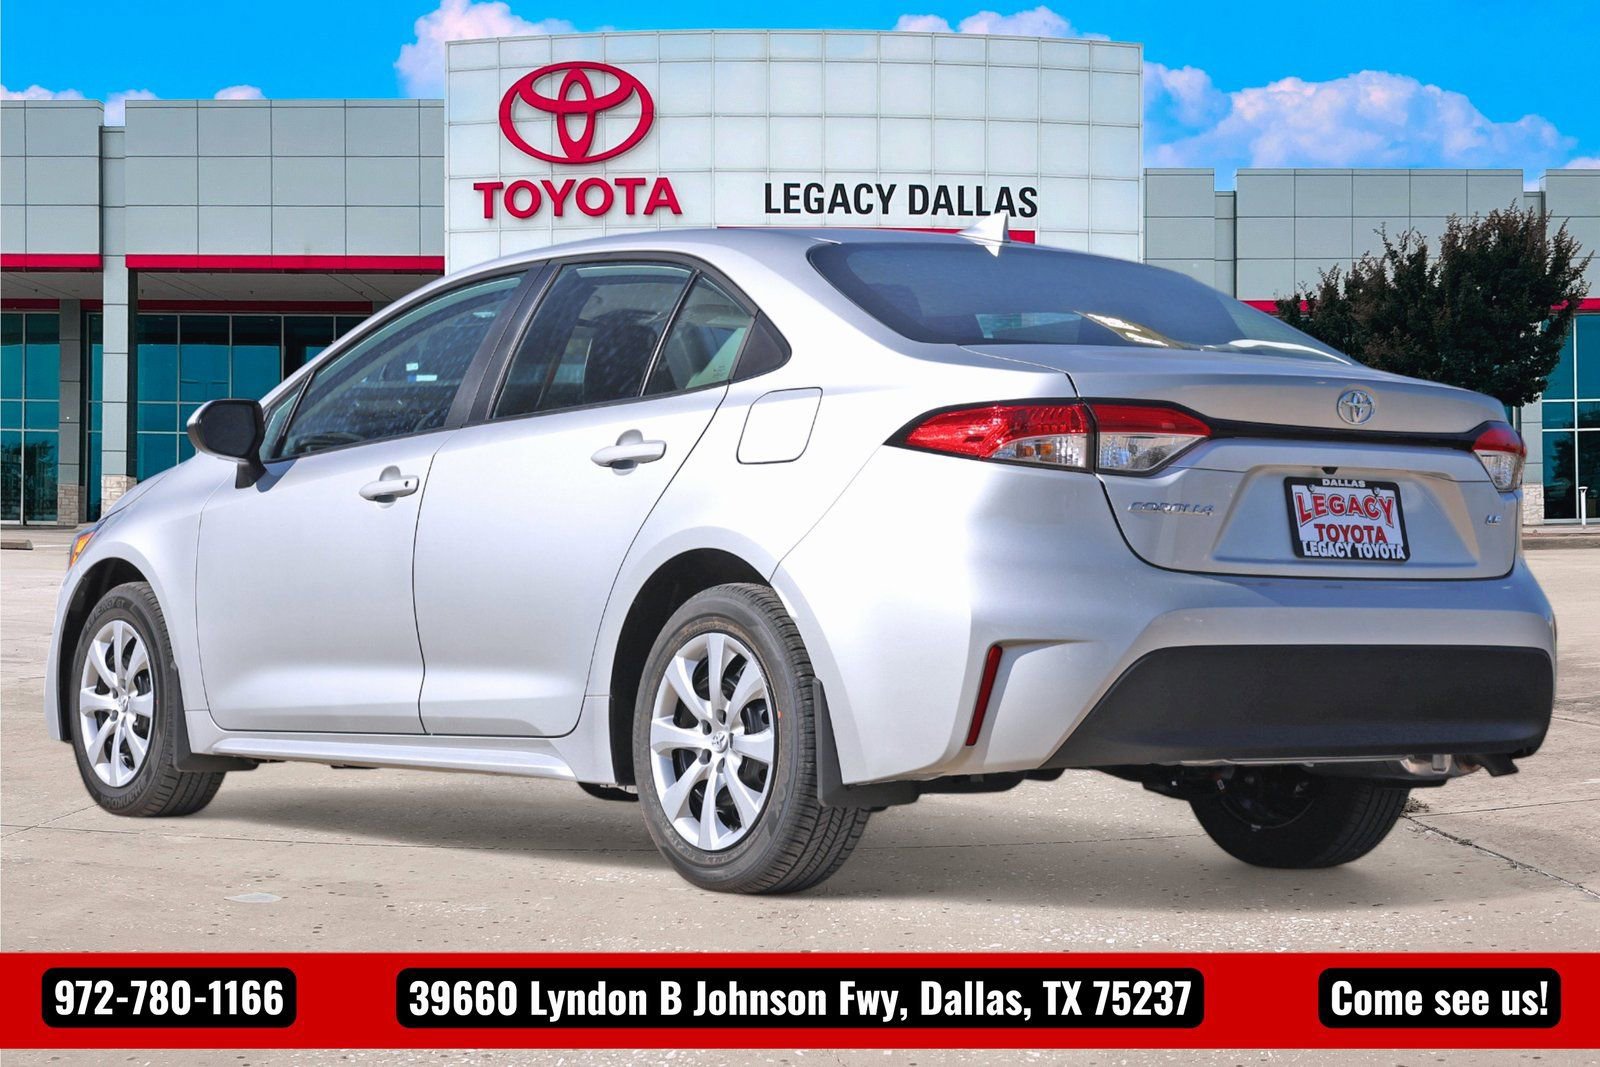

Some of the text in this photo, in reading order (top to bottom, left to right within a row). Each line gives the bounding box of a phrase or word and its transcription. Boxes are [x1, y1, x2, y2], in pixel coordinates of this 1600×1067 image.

[473, 177, 683, 219] TOYOTA
[765, 183, 1038, 218] LEGACY DALLAS
[1321, 478, 1366, 488] DALLAS
[1295, 492, 1395, 528] LEGACY
[1314, 523, 1388, 544] TOYOTA
[1301, 540, 1406, 560] LEGACY TOYOTA
